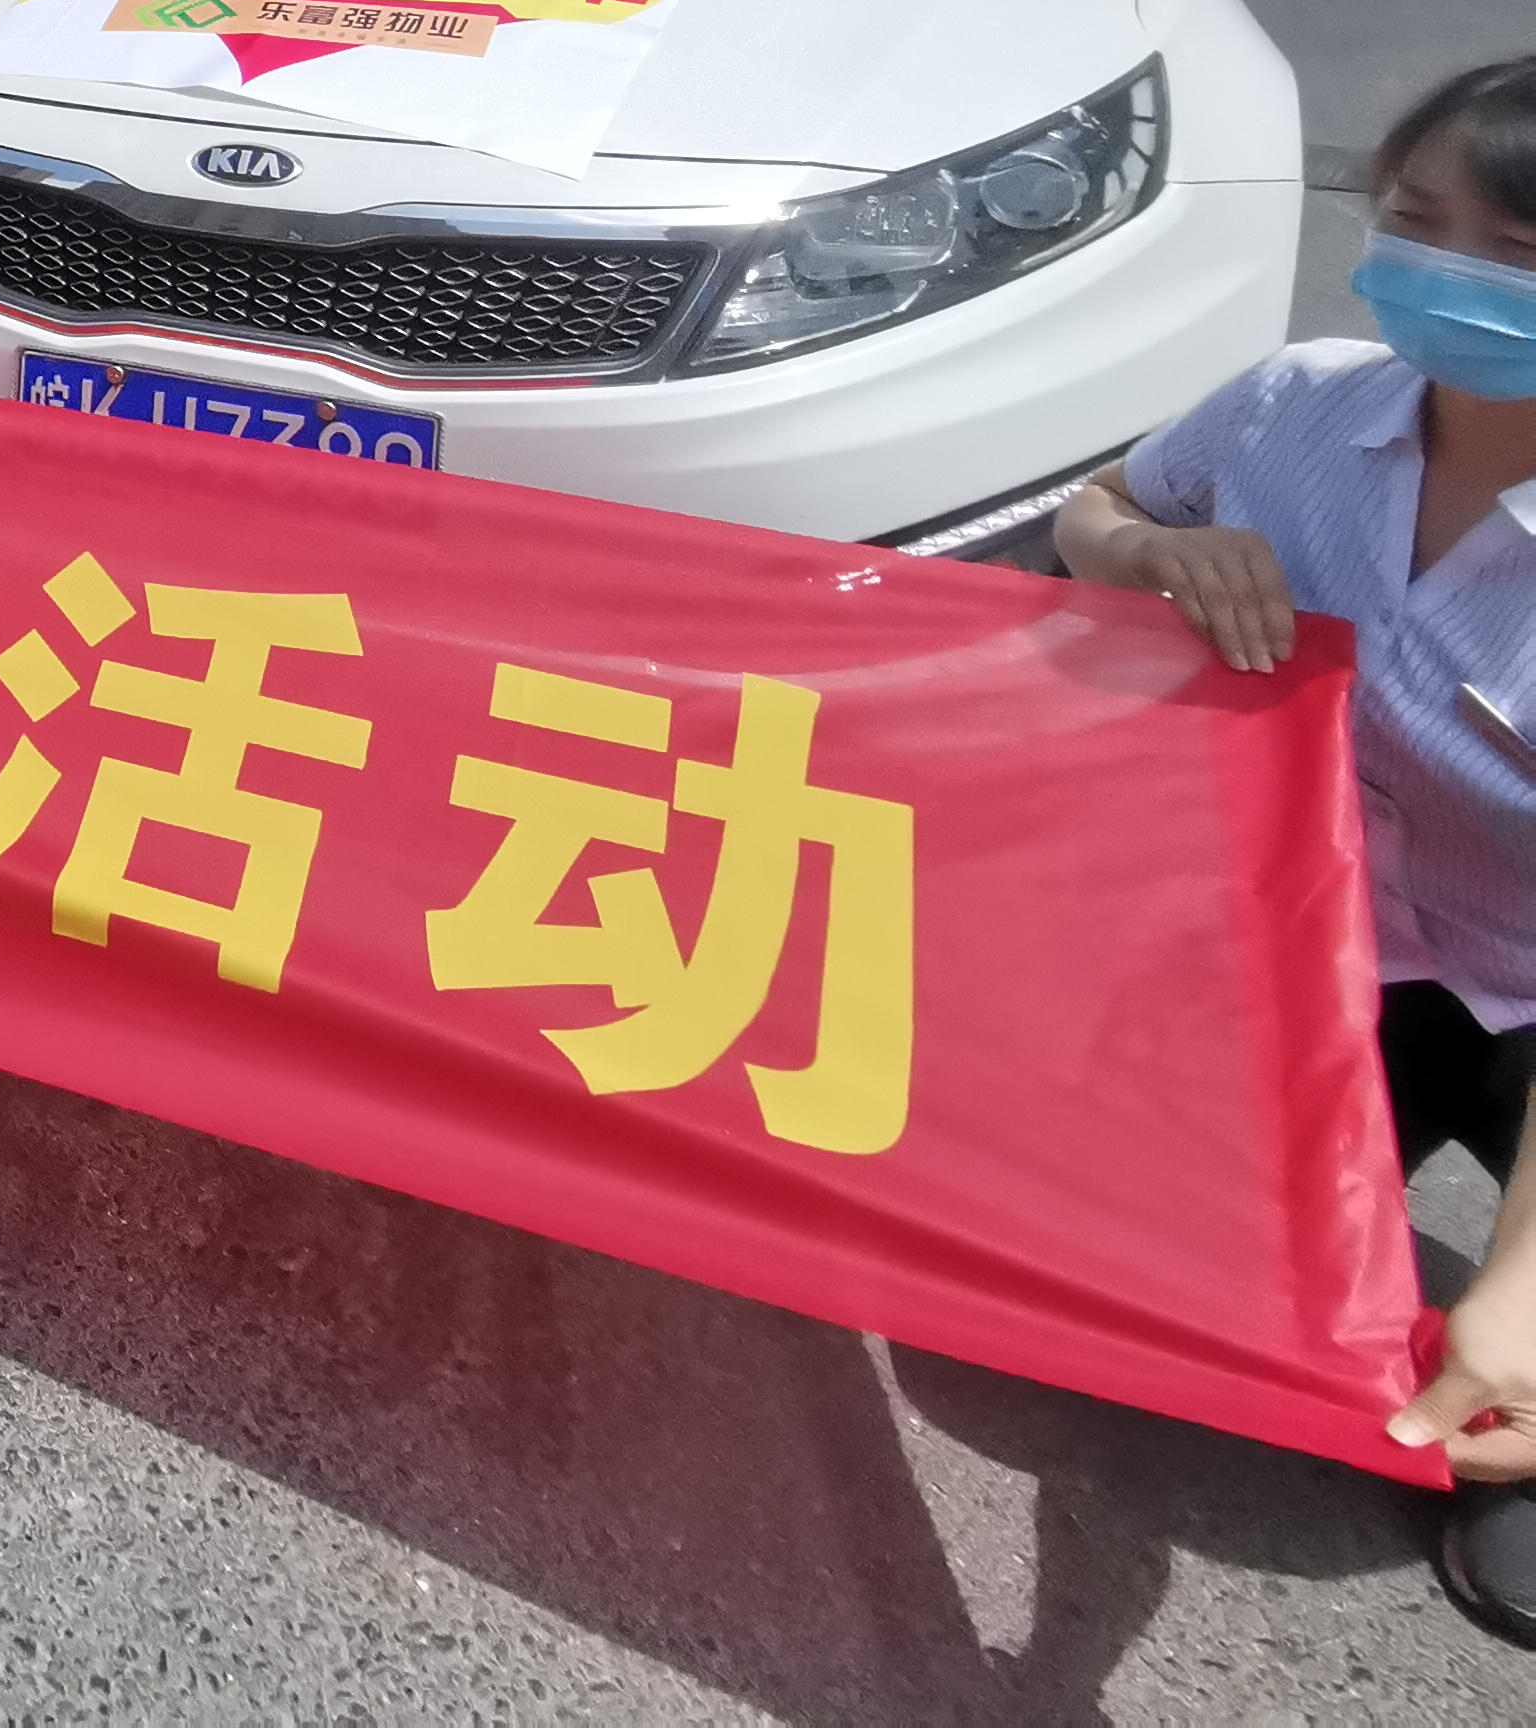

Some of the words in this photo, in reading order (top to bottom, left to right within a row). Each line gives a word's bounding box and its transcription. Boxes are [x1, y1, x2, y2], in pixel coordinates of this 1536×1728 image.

[257, 0, 469, 41] 乐富强物业
[207, 145, 282, 177] KIA
